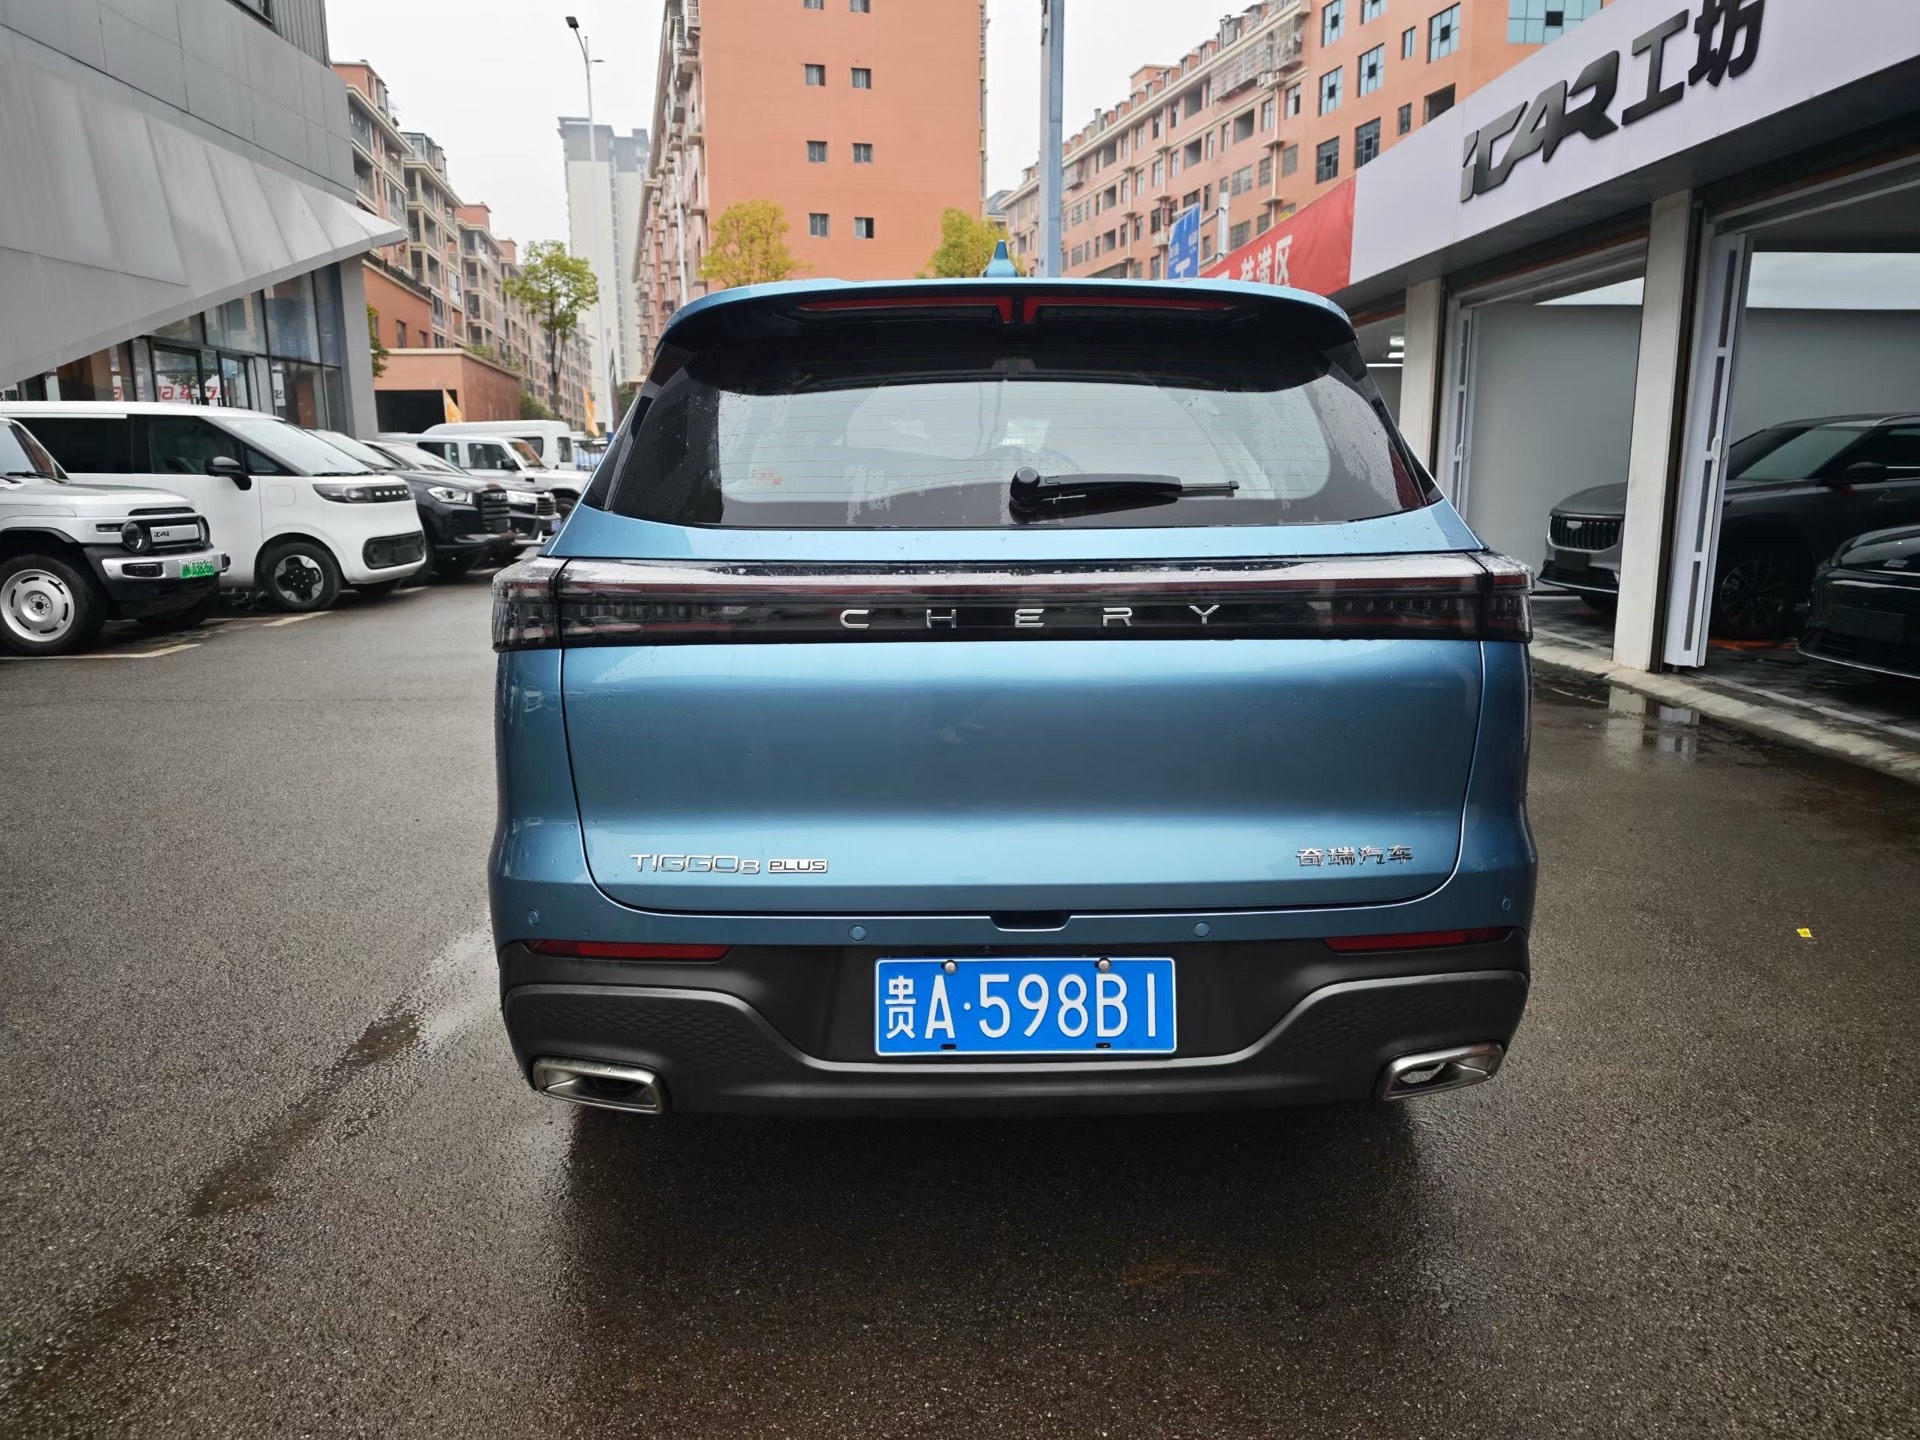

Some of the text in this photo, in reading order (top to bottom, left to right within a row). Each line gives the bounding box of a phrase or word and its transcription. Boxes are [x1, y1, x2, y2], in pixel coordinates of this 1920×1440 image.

[839, 604, 1220, 629] CHERY
[768, 859, 827, 872] PLUS
[1296, 844, 1414, 866] 奇瑞汽车
